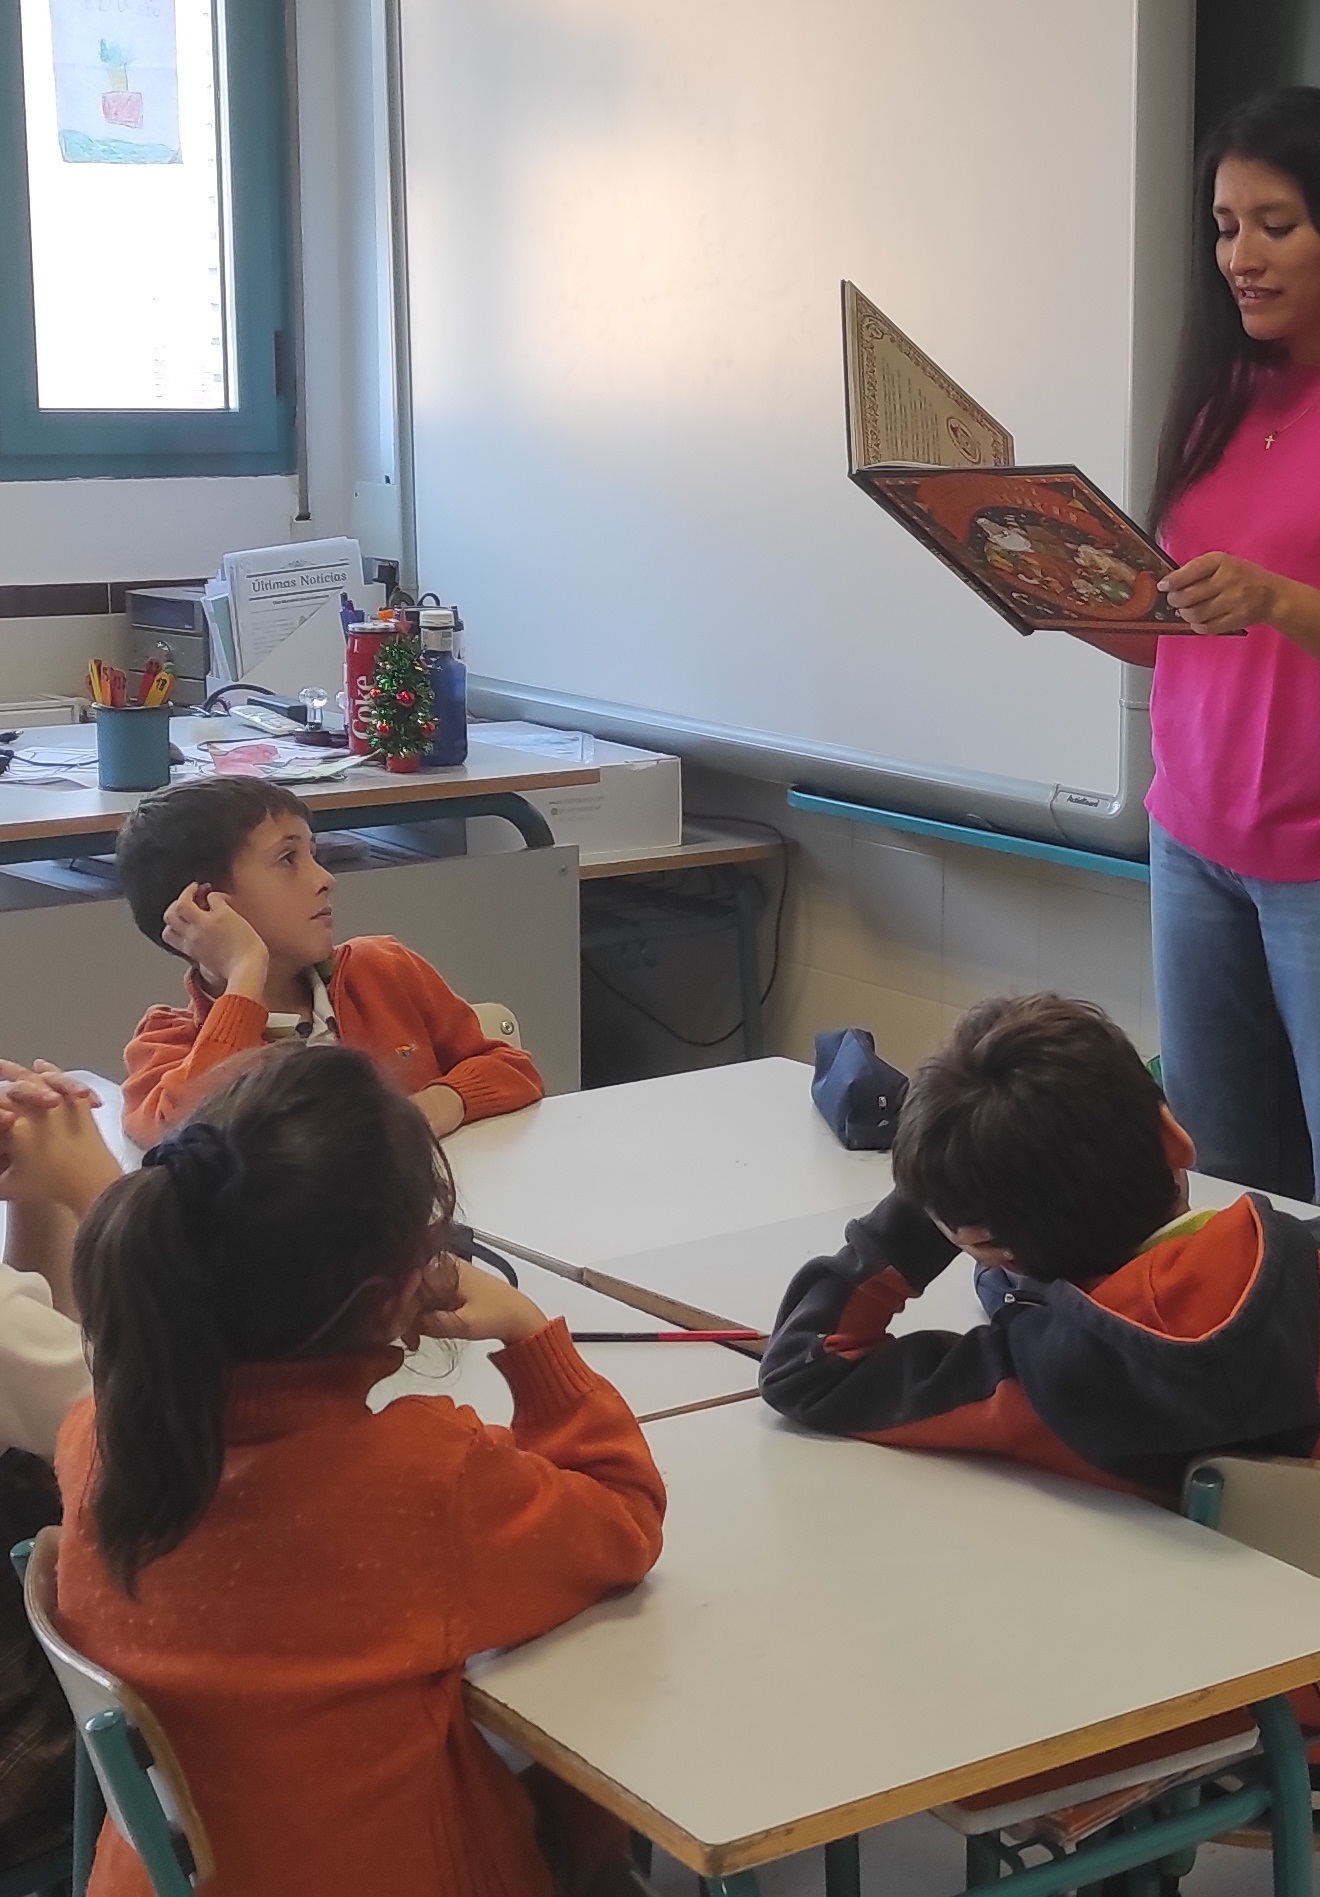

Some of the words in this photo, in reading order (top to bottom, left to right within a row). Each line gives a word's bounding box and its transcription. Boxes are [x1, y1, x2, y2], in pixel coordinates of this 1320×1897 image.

[251, 578, 297, 593] Últimas
[299, 571, 347, 586] Noticias
[352, 675, 377, 740] Coke
